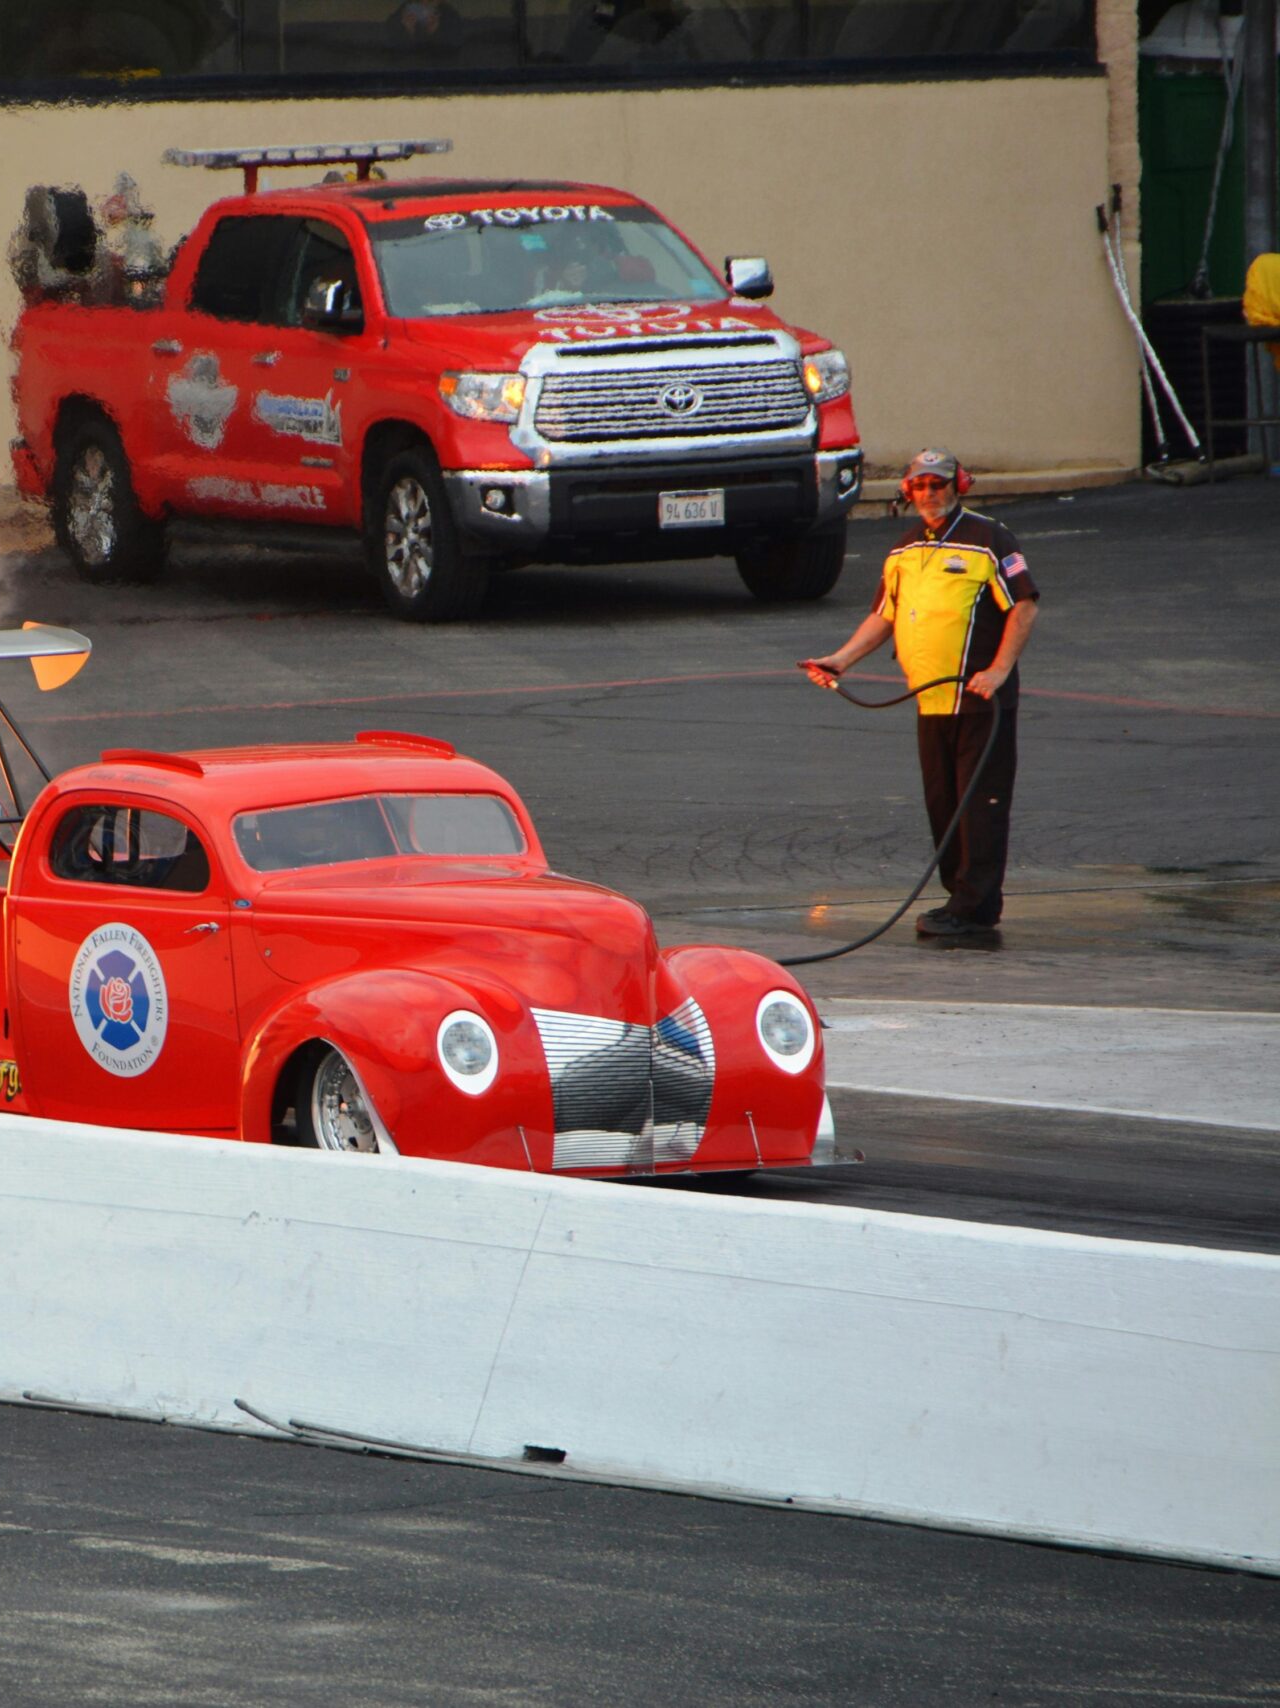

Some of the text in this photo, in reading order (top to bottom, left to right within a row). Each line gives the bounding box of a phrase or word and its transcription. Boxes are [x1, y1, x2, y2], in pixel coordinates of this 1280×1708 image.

[471, 205, 615, 225] TOYOTA
[666, 502, 681, 520] 94
[684, 501, 706, 519] 636
[72, 929, 164, 1022] NATIONAL FALLEN FIREFIGHTERS
[91, 1041, 154, 1071] FOUNDATION
